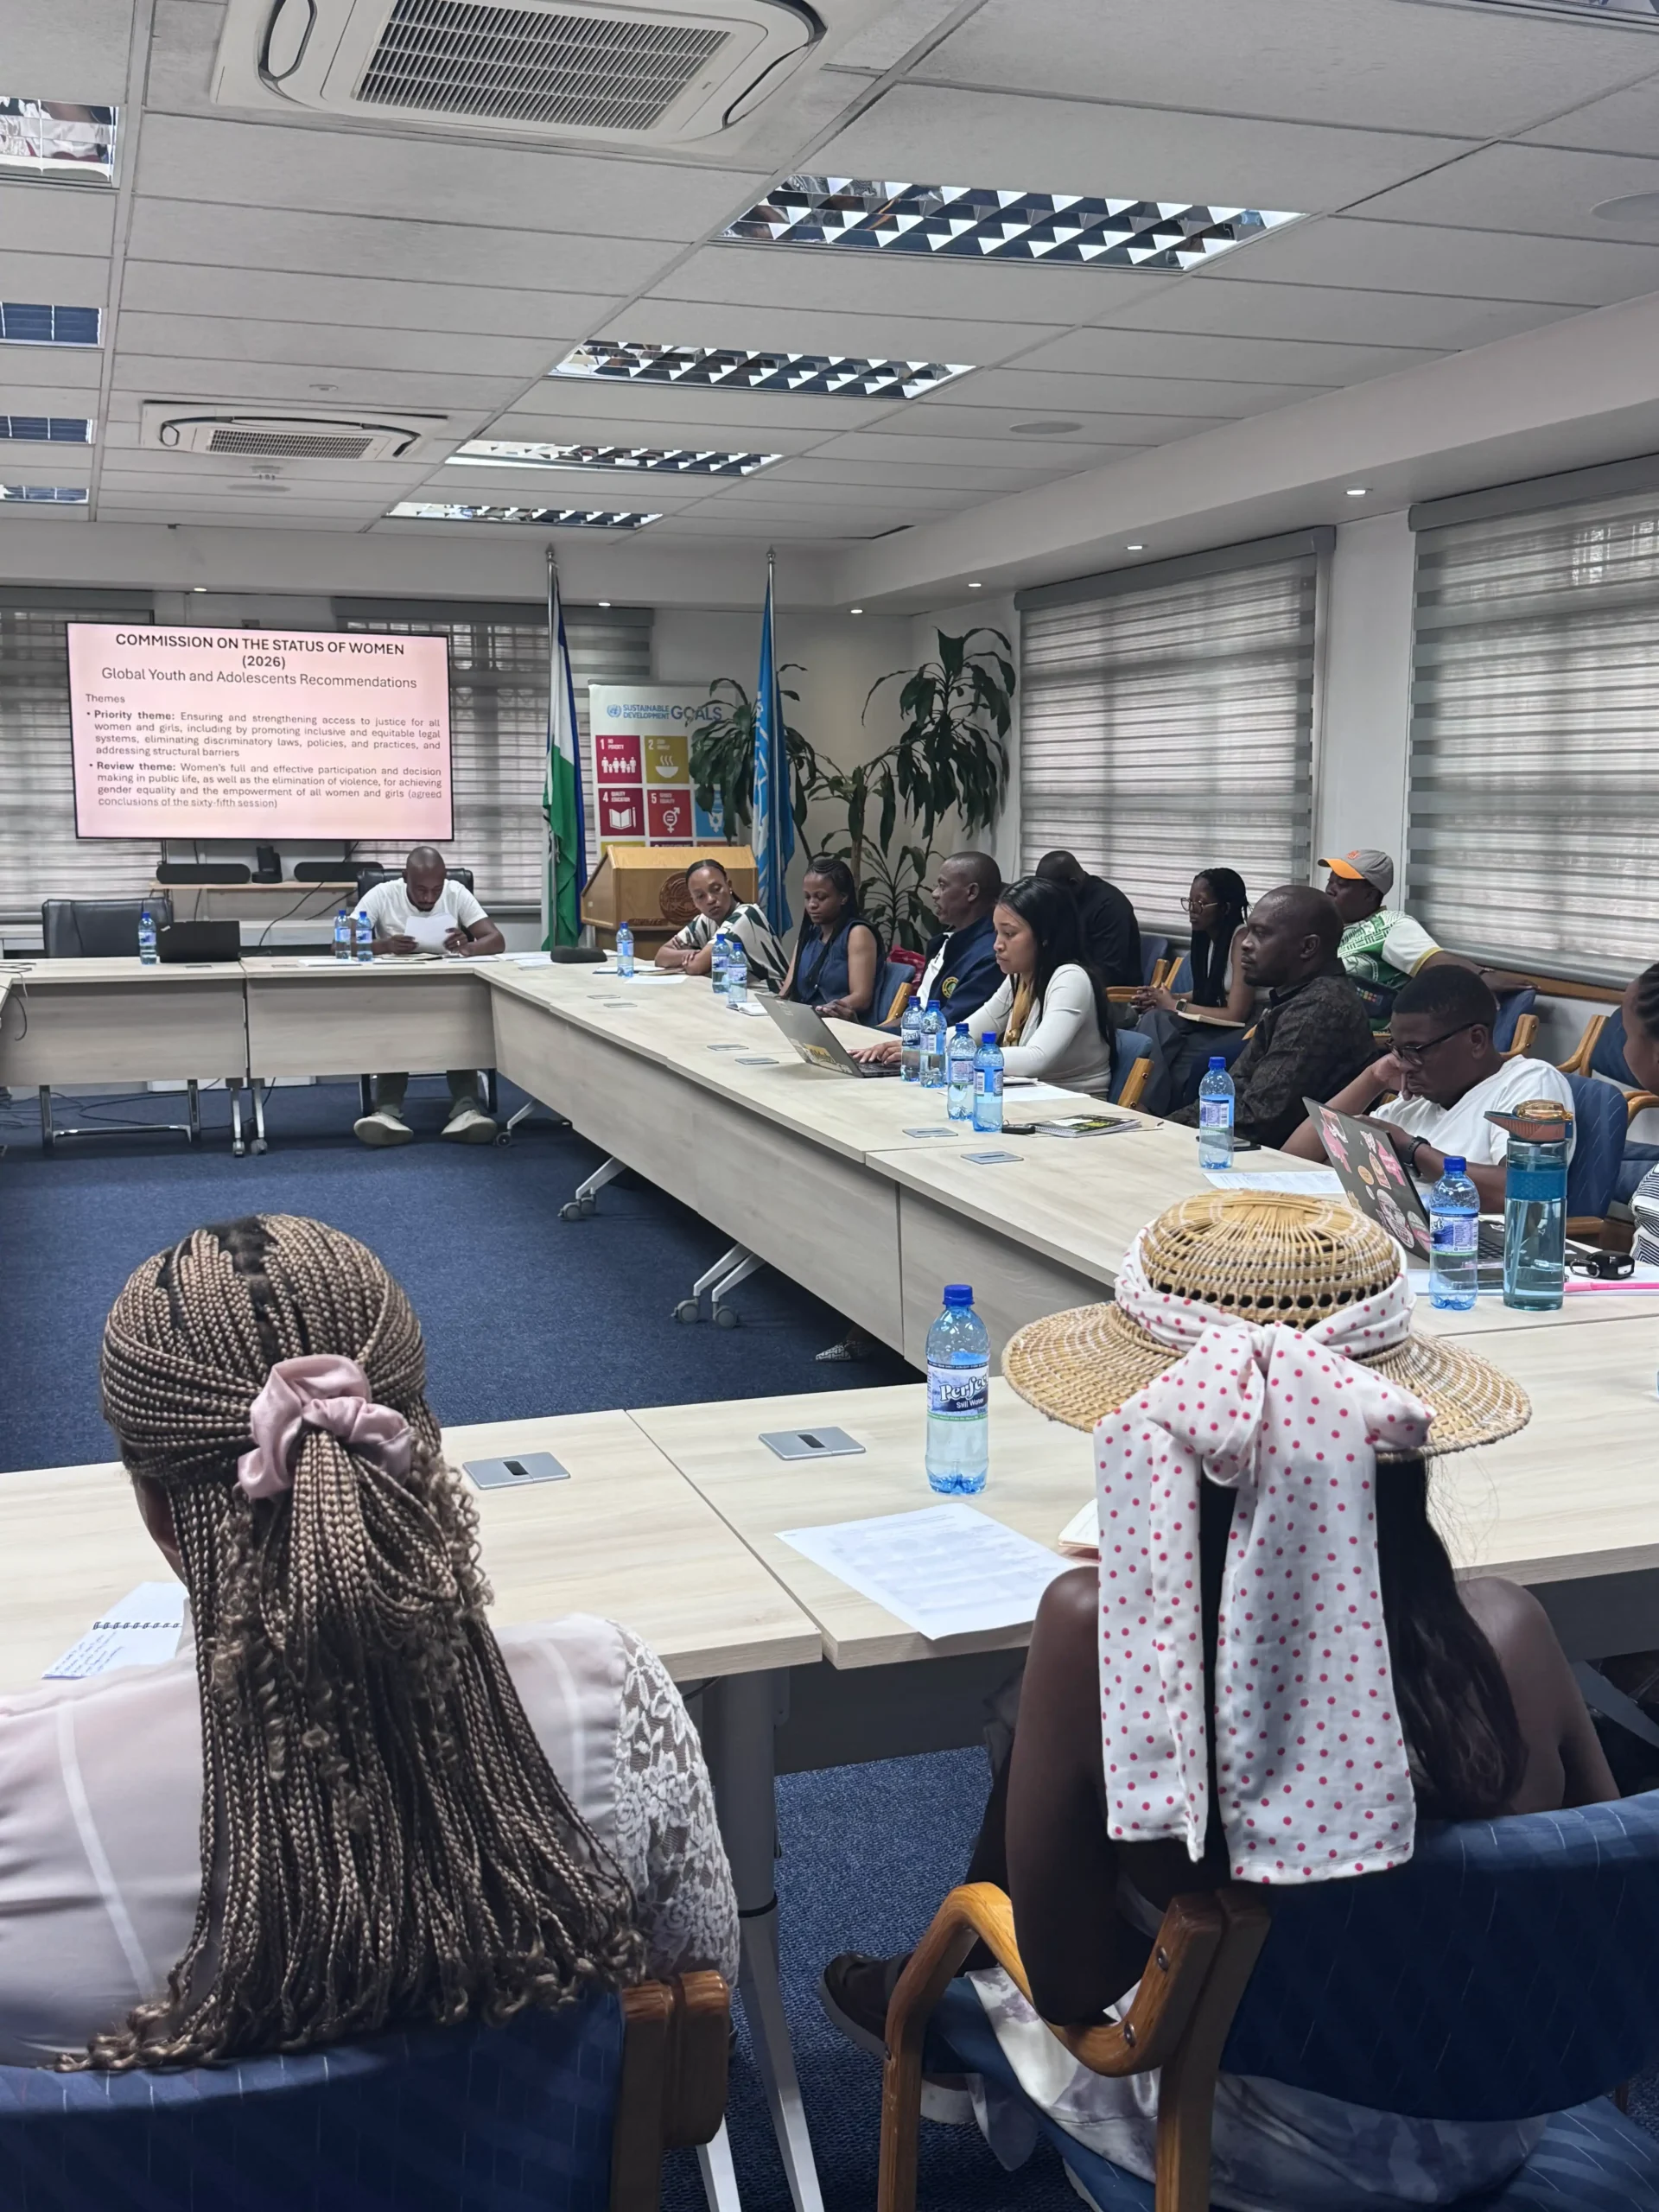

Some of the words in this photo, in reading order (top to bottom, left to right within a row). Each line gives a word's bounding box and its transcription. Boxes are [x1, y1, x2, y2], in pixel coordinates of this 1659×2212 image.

[116, 633, 213, 648] COMMISSION
[217, 638, 238, 649] ON
[242, 638, 269, 650] THE
[273, 639, 324, 652] STATUS
[327, 641, 346, 653] OF
[349, 643, 404, 655] WOMEN
[242, 655, 286, 670] (2026)
[102, 667, 145, 680] Global
[149, 669, 186, 681] Youth
[189, 671, 213, 683] and
[216, 671, 296, 685] Adolescents
[300, 674, 417, 689] Recommendations
[86, 694, 125, 703] Themes
[94, 710, 132, 721] Priority
[138, 711, 175, 721] theme:
[181, 712, 223, 723] Ensuring
[228, 714, 246, 722] and
[252, 715, 317, 726] strengthening
[375, 717, 406, 727] justice
[671, 705, 722, 721] GOALS
[159, 724, 182, 733] girls,
[187, 724, 232, 734] including
[236, 726, 247, 735] by
[251, 726, 301, 736] promoting
[304, 728, 346, 736] inclusive
[372, 729, 415, 738] equitable
[418, 729, 441, 740] legal
[95, 735, 139, 744] systems,
[145, 735, 199, 746] eliminating
[204, 736, 273, 747] discriminatory
[277, 738, 302, 747] laws,
[308, 739, 346, 748] policies,
[373, 741, 419, 750] practices,
[423, 741, 441, 750] and
[601, 739, 605, 750] 1
[648, 740, 653, 750] 2
[96, 747, 150, 757] addressing
[153, 747, 200, 756] structural
[202, 748, 239, 757] barriers
[97, 761, 134, 770] Review
[139, 762, 175, 771] theme:
[230, 764, 245, 772] full
[273, 765, 314, 773] effective
[318, 766, 377, 776] participation
[403, 767, 442, 776] decision
[97, 774, 133, 784] making
[149, 774, 180, 784] public
[181, 775, 200, 784] life,
[254, 776, 270, 785] the
[272, 776, 325, 785] elimination
[340, 778, 381, 786] violence,
[399, 779, 442, 788] achieving
[98, 786, 131, 795] gender
[137, 786, 176, 796] equality
[180, 786, 199, 795] and
[223, 788, 292, 797] empowerment
[309, 788, 321, 797] all
[385, 790, 404, 798] girls
[408, 790, 442, 799] (agreed
[603, 791, 608, 802] 4
[652, 793, 657, 804] 5
[99, 797, 158, 806] conclusions
[161, 798, 171, 806] of
[173, 798, 188, 806] the
[191, 798, 235, 808] sixty-fifth
[238, 799, 277, 809] session)
